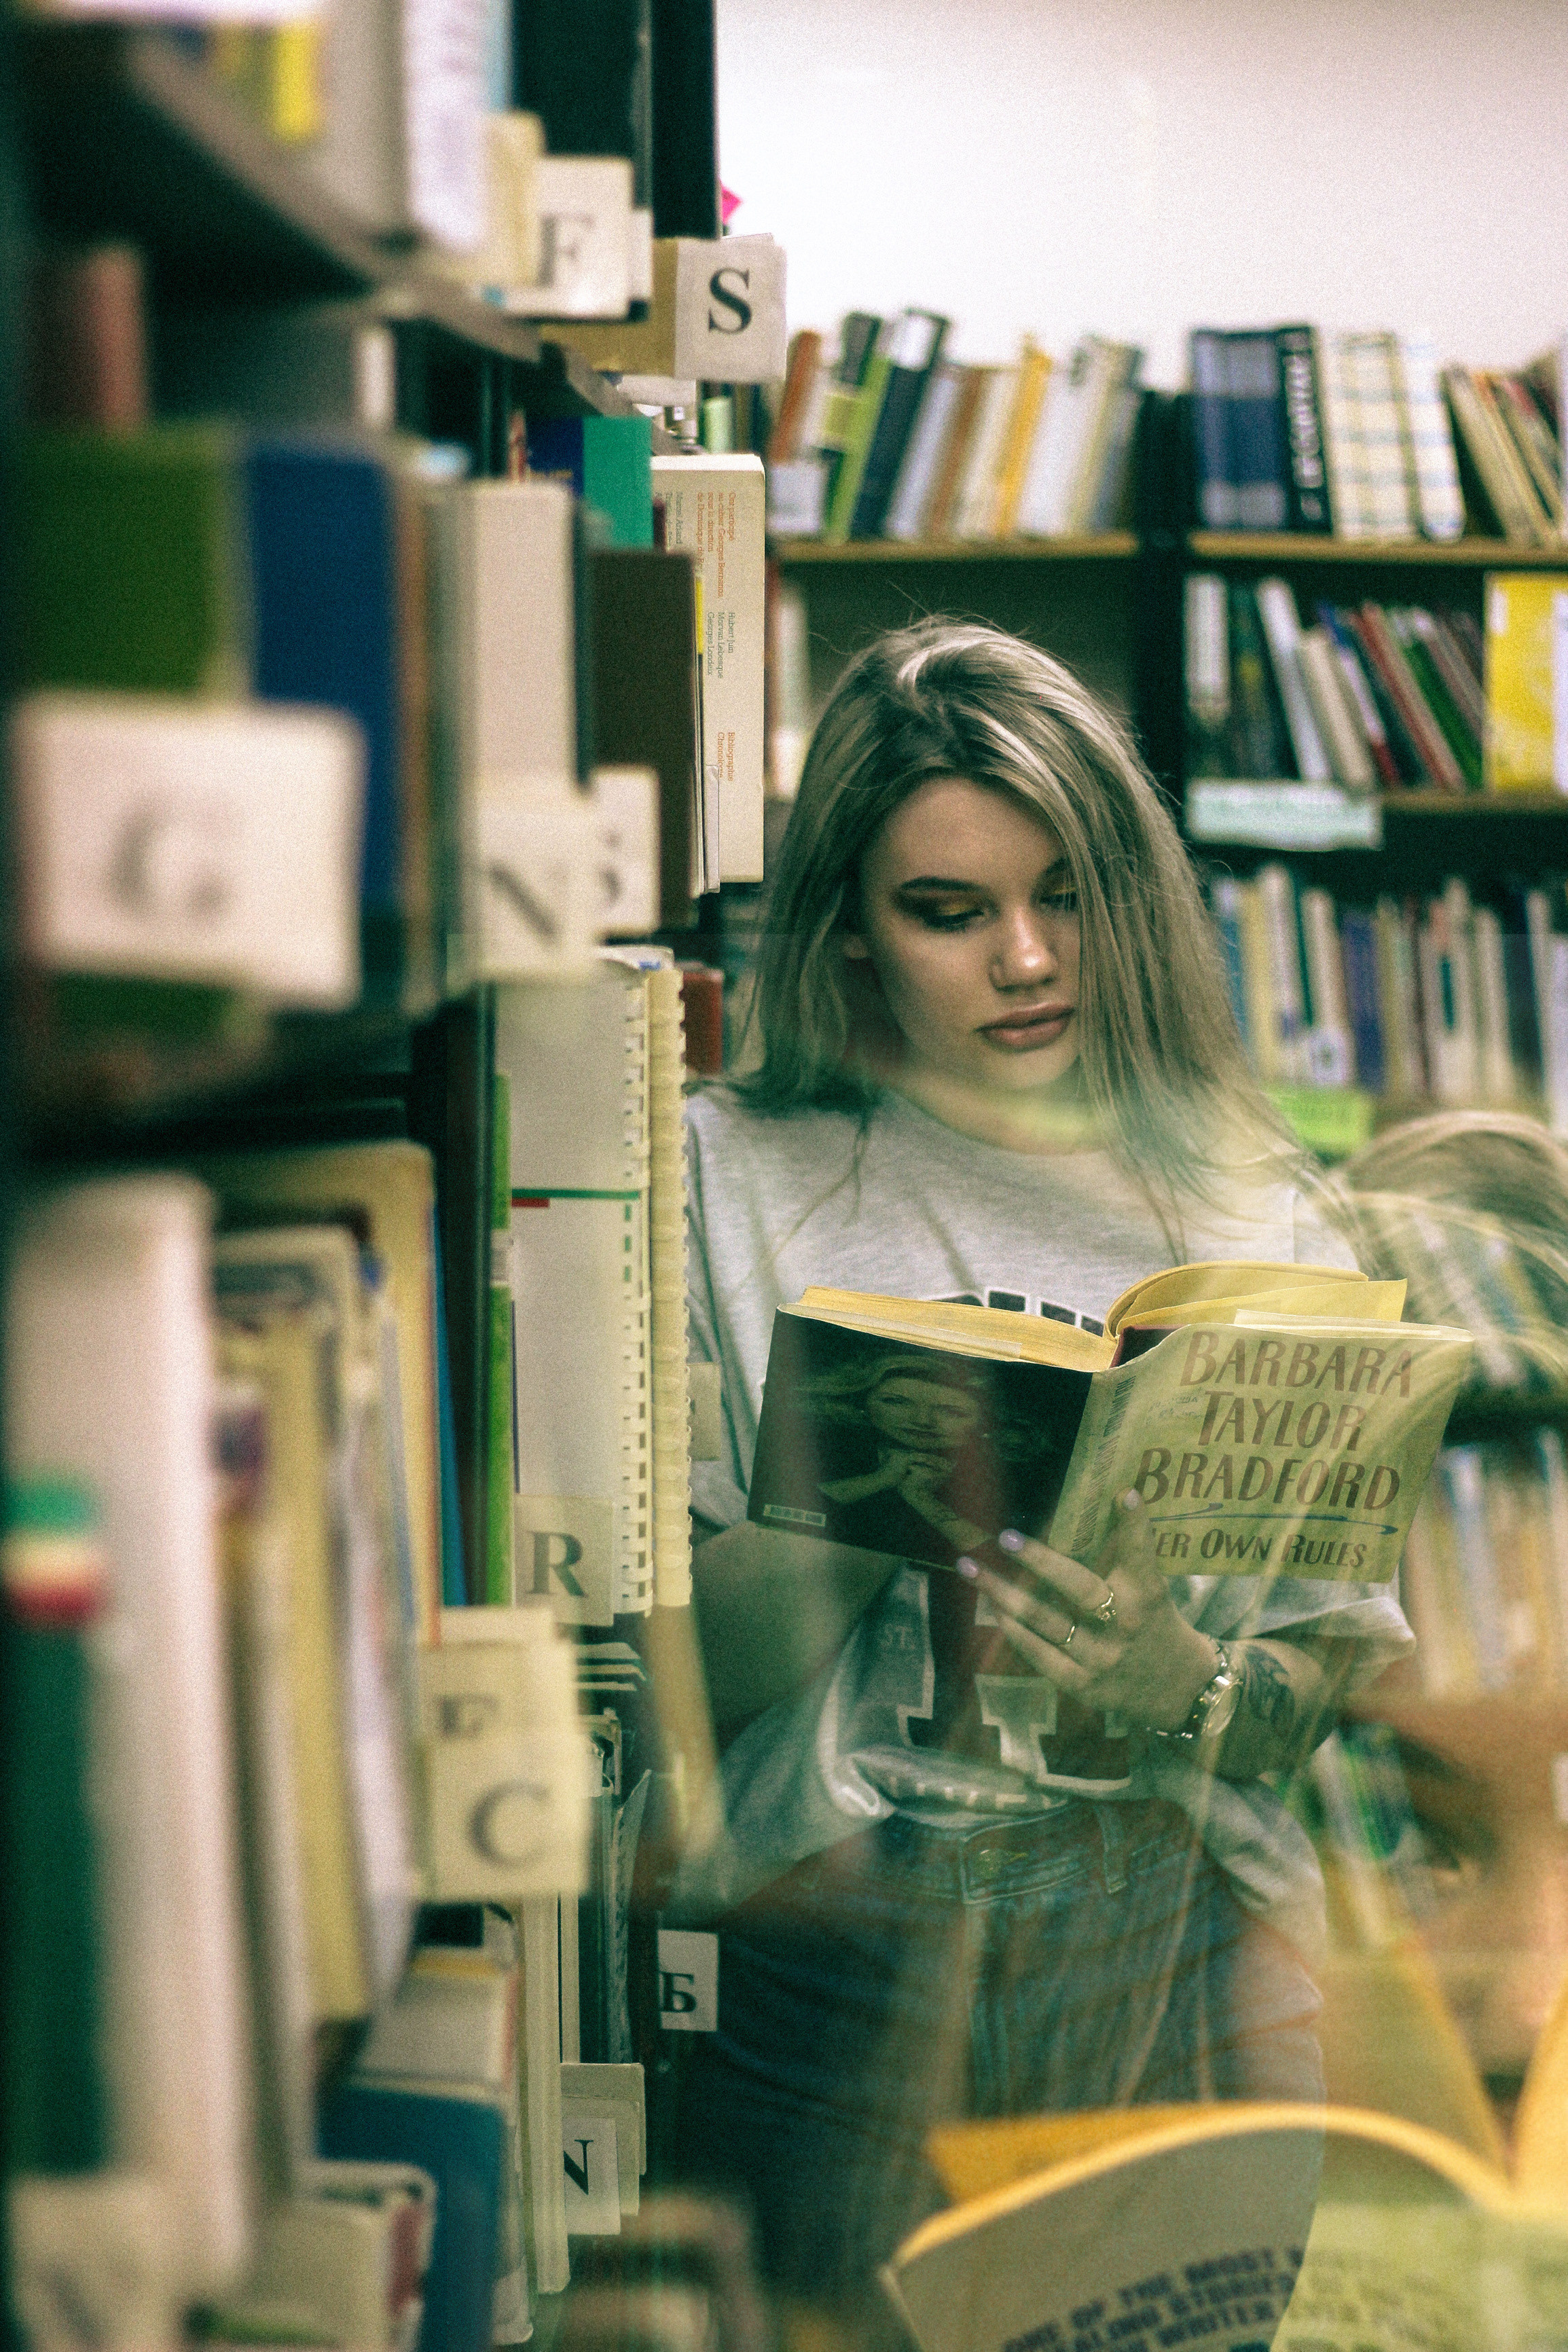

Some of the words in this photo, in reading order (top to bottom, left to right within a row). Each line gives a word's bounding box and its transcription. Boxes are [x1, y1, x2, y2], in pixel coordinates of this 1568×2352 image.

[708, 268, 753, 335] S
[695, 503, 704, 545] Dominique
[716, 528, 725, 560] Georges
[705, 612, 714, 645] Georges
[715, 641, 725, 679] Lebesque
[725, 731, 735, 782] Bibliographie
[1180, 1331, 1414, 1398] BARBARA
[1197, 1390, 1366, 1451] TAYLOR
[1135, 1447, 1400, 1510] BRADFORD
[526, 1530, 587, 1598] R
[1152, 1527, 1192, 1559] ER
[1201, 1528, 1274, 1561] OWN
[1281, 1534, 1367, 1568] RULES
[467, 1779, 553, 1870] C
